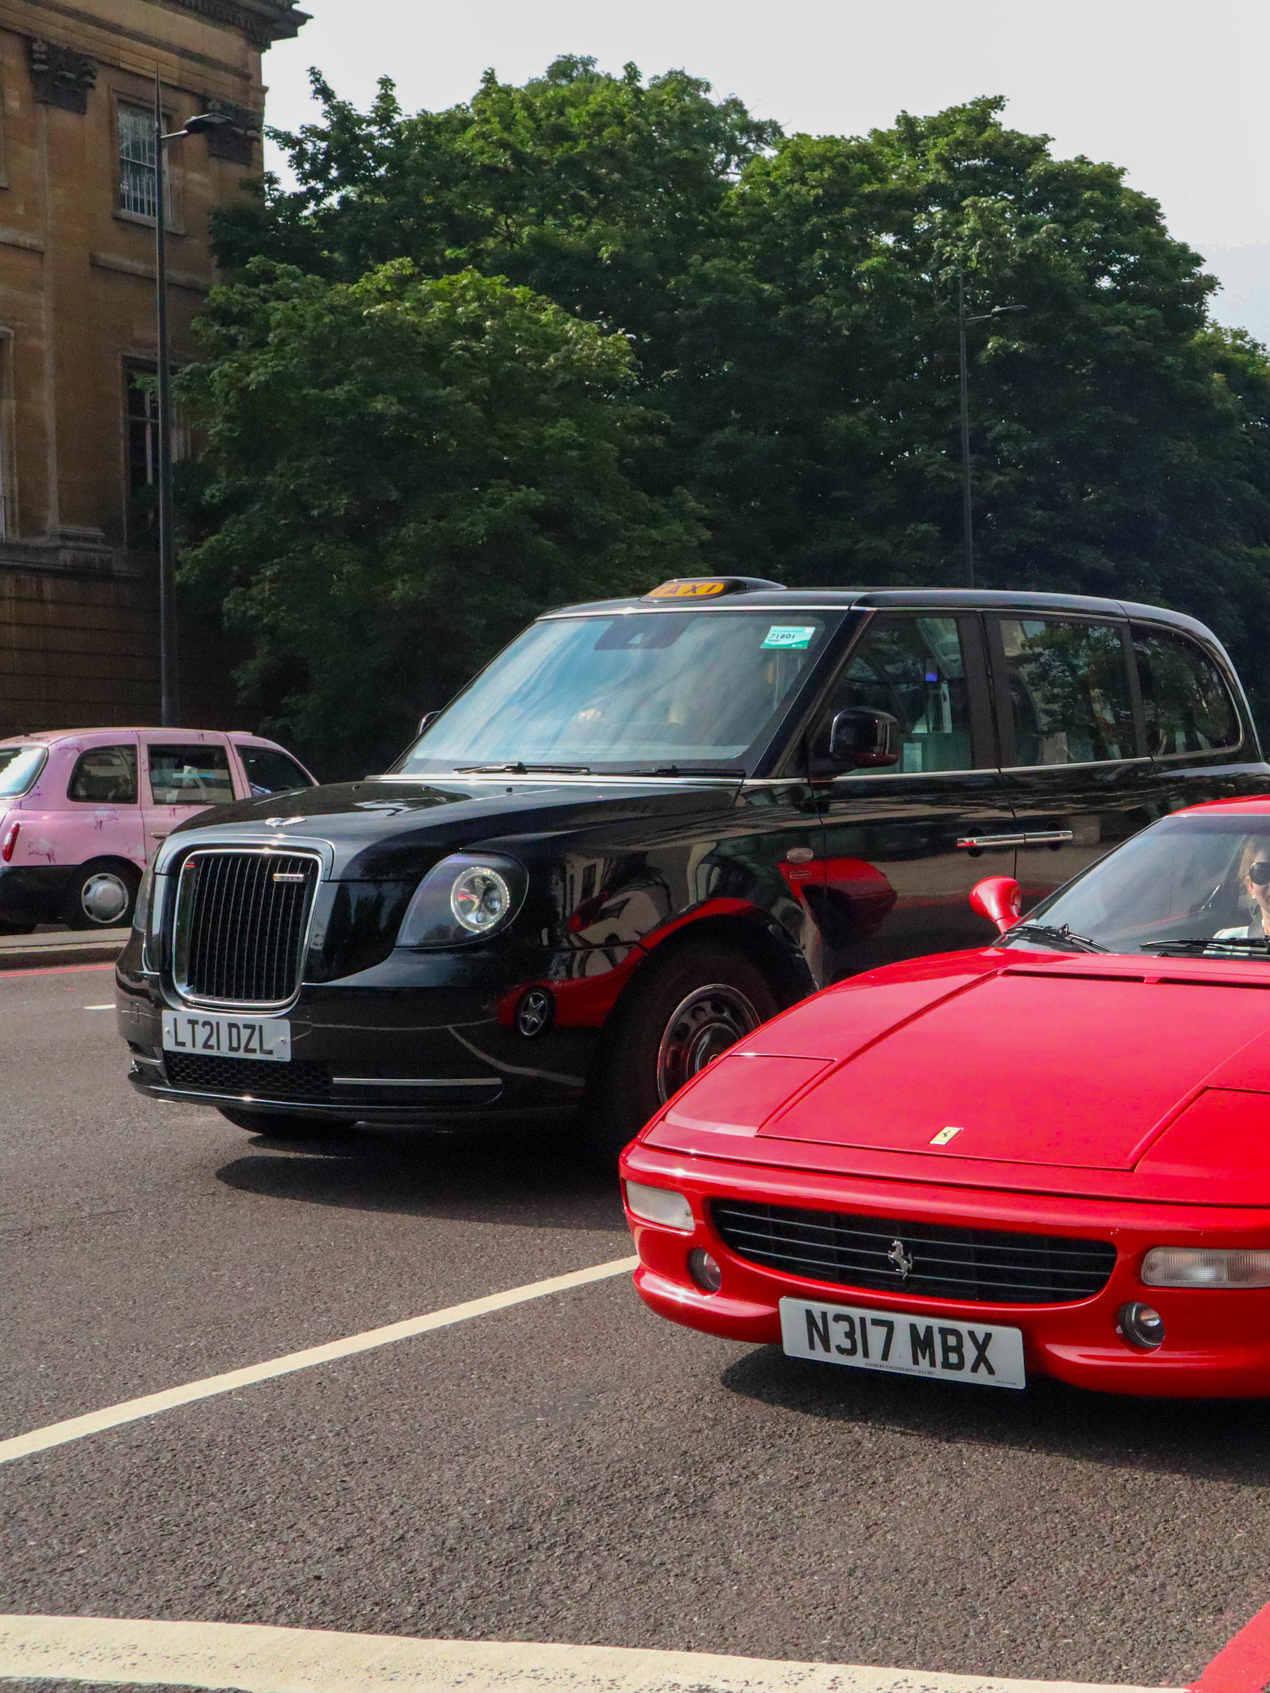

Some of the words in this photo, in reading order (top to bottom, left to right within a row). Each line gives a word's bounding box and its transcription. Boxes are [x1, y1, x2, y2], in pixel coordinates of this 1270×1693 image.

[655, 584, 717, 596] TAXI
[173, 1017, 221, 1051] LT21
[227, 1022, 274, 1055] DZL
[805, 1309, 895, 1362] N317
[909, 1322, 996, 1376] MBX
